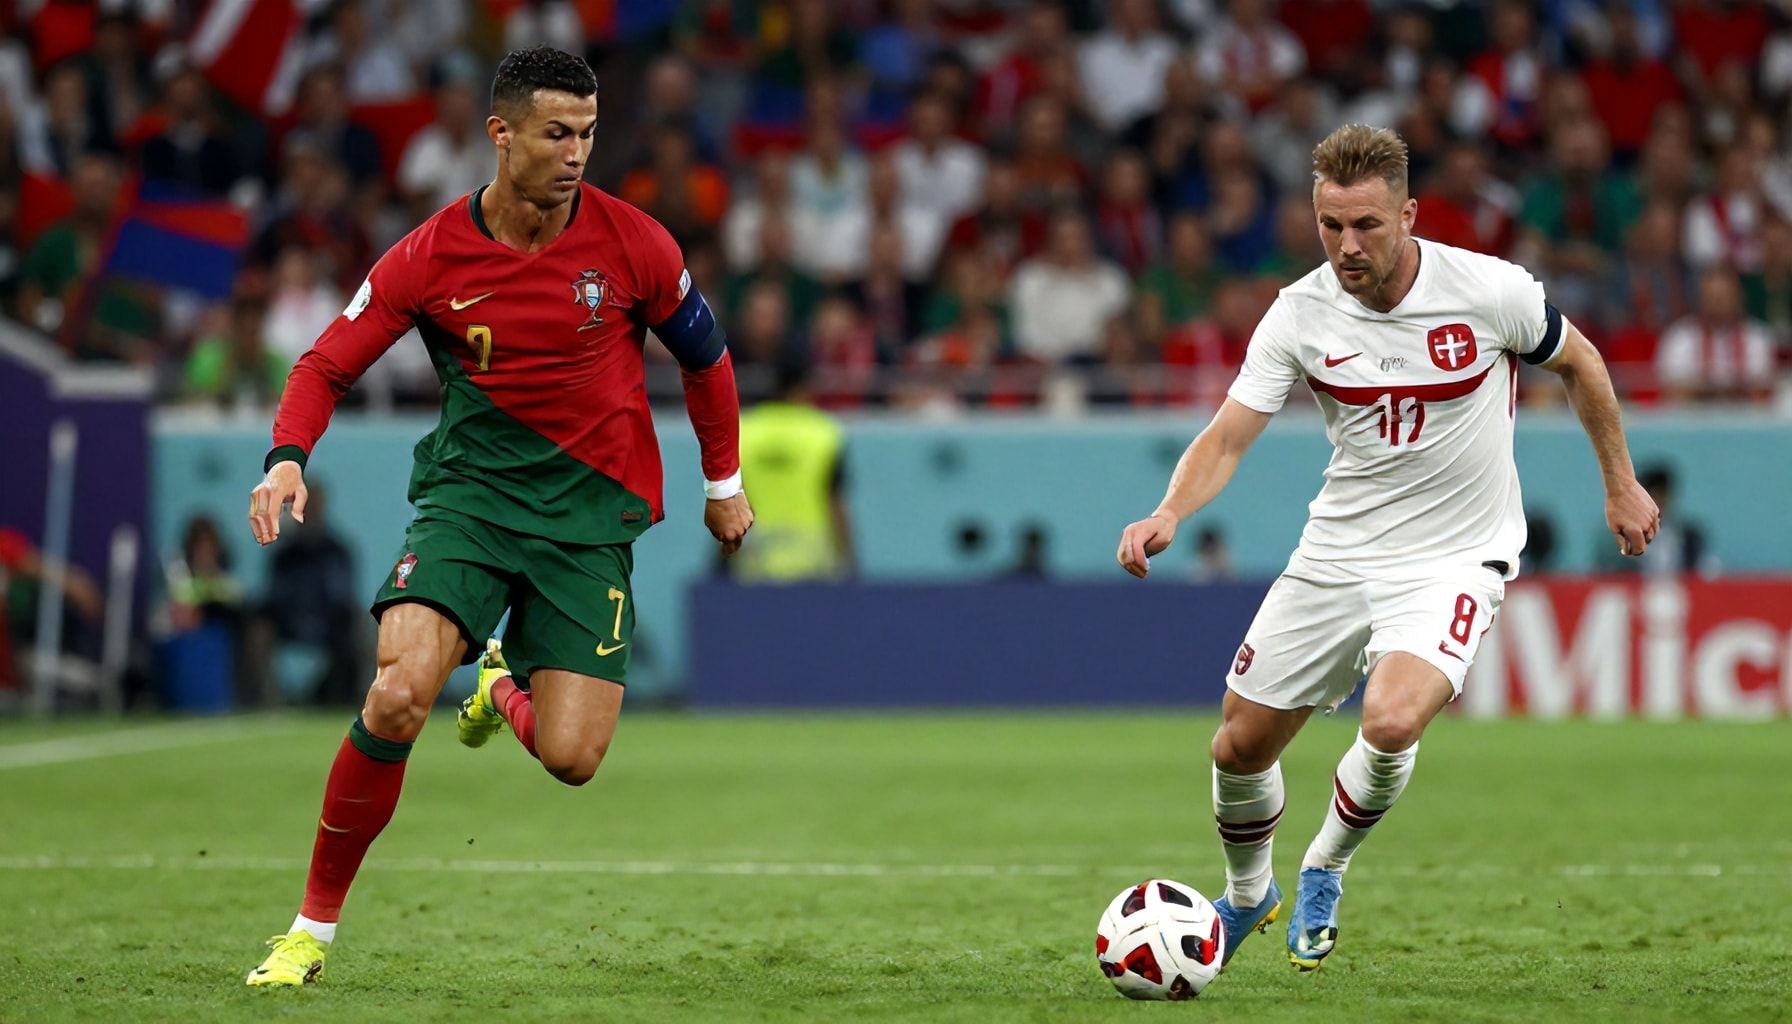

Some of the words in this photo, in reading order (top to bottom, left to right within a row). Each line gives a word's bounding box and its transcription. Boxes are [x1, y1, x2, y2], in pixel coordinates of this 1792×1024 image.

[608, 586, 625, 641] 7
[1449, 592, 1477, 647] 8
[1470, 577, 1792, 723] Mic
